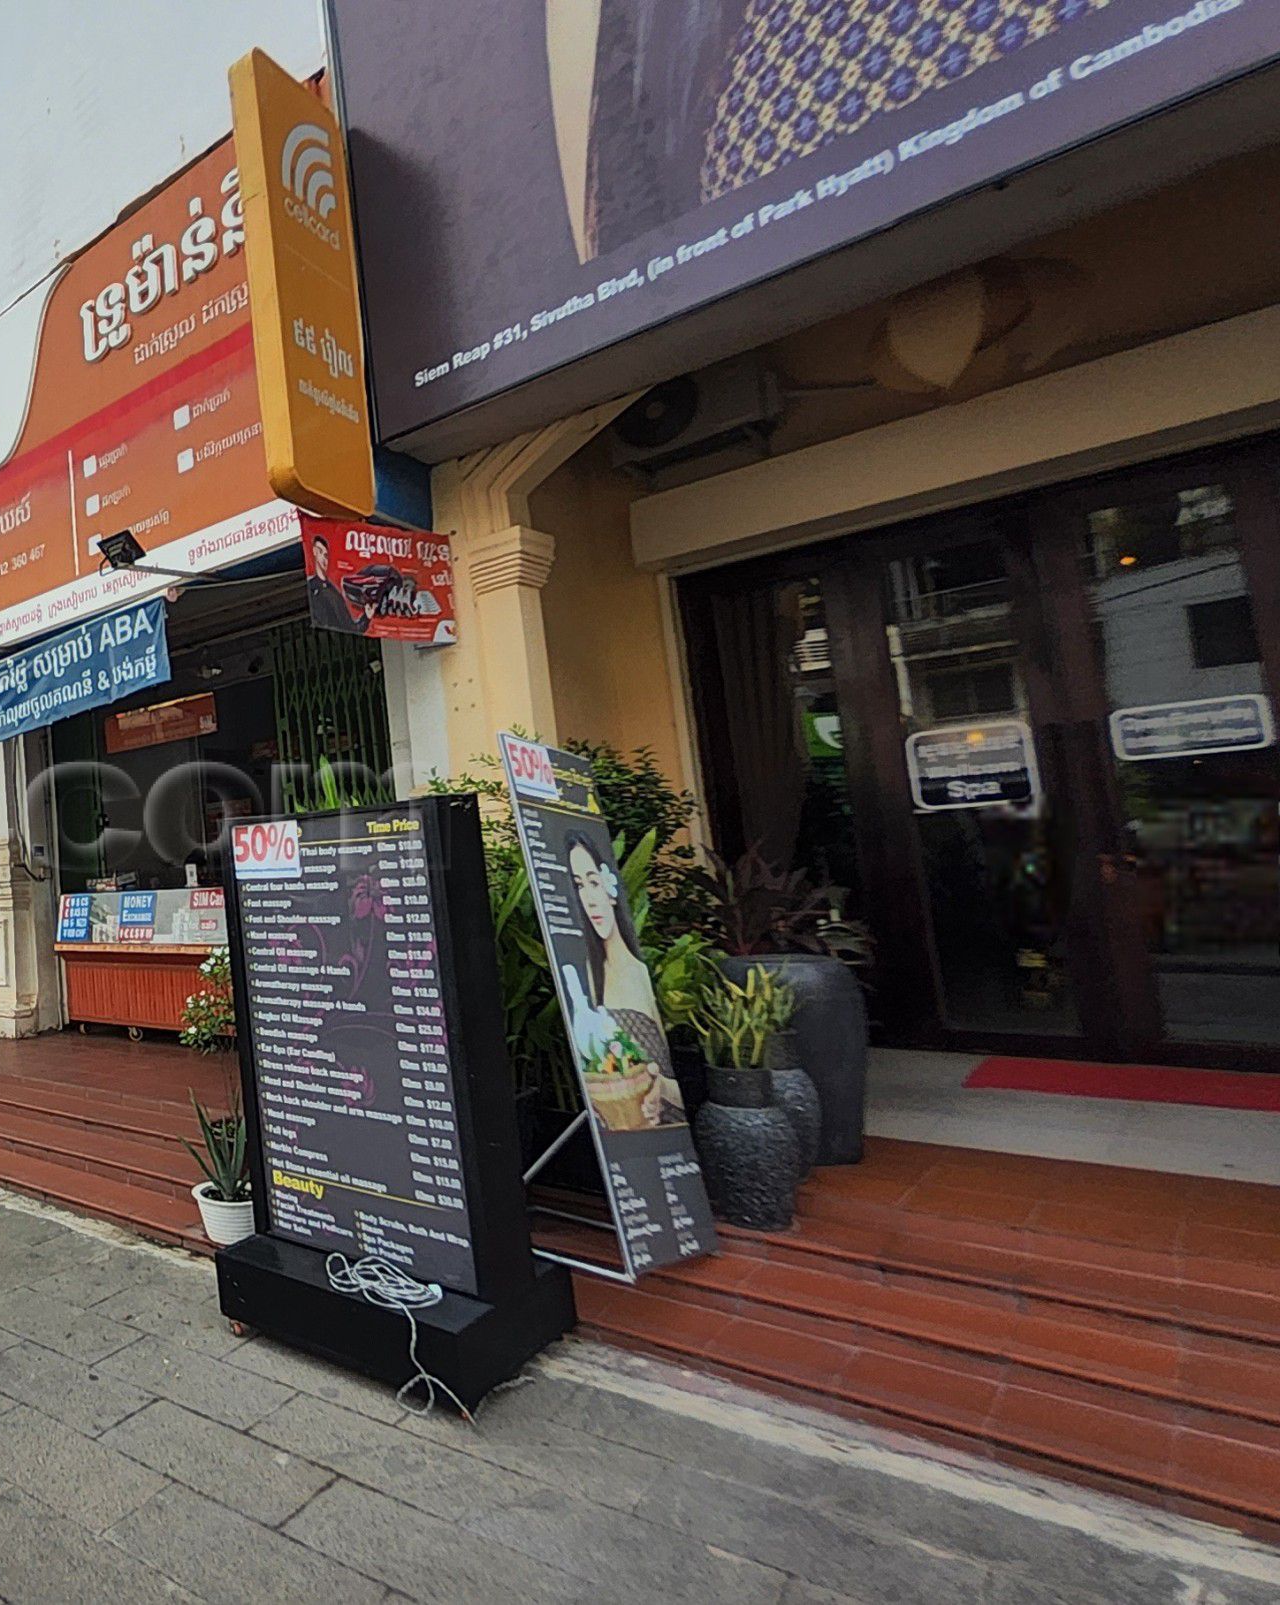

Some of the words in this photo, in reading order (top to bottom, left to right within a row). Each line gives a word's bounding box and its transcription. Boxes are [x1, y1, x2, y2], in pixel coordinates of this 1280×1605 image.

[415, 358, 449, 388] Siem
[452, 340, 491, 371] Reap
[530, 292, 595, 332] Sivutha
[675, 227, 729, 265] front
[730, 212, 756, 240] of
[758, 188, 816, 228] Park
[897, 91, 1027, 162] Kingdom
[1028, 67, 1064, 100] of
[32, 624, 92, 679] សម្រាប់
[99, 607, 155, 653] ABA
[97, 670, 111, 691] &
[507, 742, 555, 785] 50%
[946, 781, 1002, 800] Spa
[365, 820, 391, 834] Time
[392, 818, 420, 832] Price
[234, 823, 296, 864] 50%
[192, 891, 209, 906] SIM
[272, 1168, 324, 1200] Beauty
